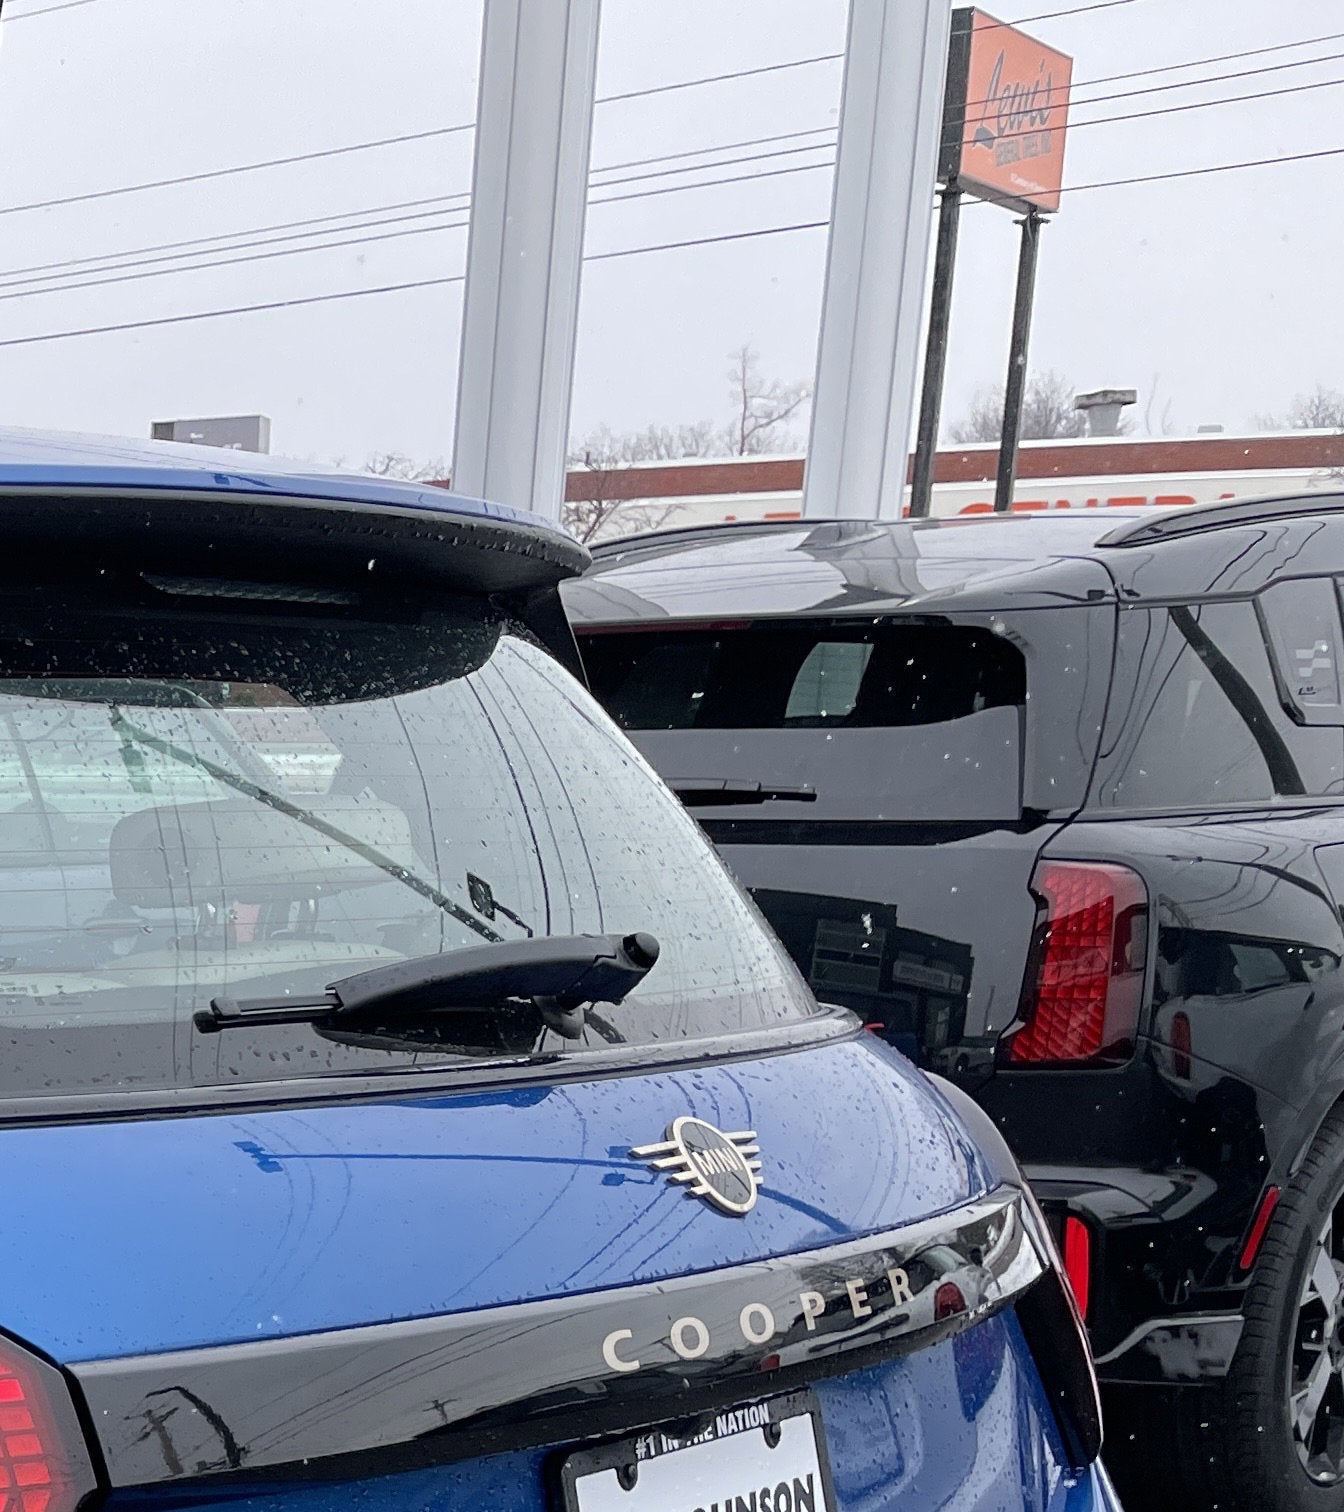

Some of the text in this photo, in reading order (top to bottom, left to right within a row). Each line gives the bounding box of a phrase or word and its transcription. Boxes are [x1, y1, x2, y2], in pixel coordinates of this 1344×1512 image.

[692, 1147, 744, 1176] MINI
[602, 1267, 914, 1373] COOPER
[635, 1434, 656, 1460] #1
[715, 1403, 770, 1437] NATION
